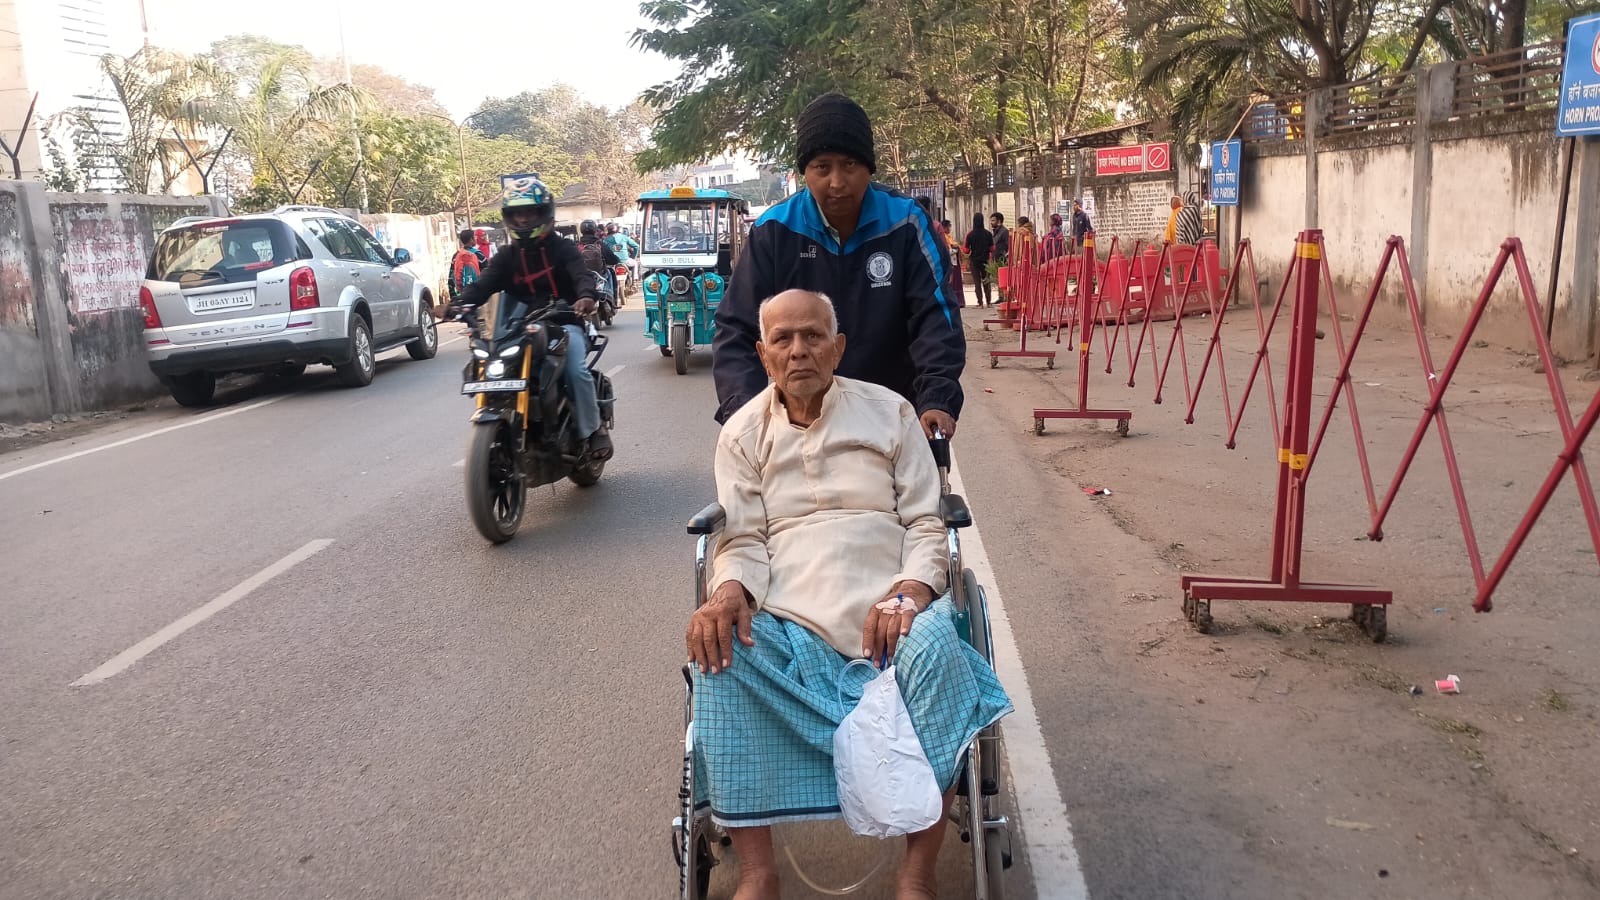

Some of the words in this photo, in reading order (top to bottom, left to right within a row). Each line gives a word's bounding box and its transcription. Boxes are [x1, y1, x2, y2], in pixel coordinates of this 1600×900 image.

[1565, 107, 1585, 124] HORN
[1585, 105, 1600, 122] PRO
[1121, 157, 1127, 166] NO
[1128, 155, 1142, 166] ENTRY
[1213, 187, 1220, 199] NO
[1220, 187, 1236, 199] PARKING
[196, 298, 208, 309] JH
